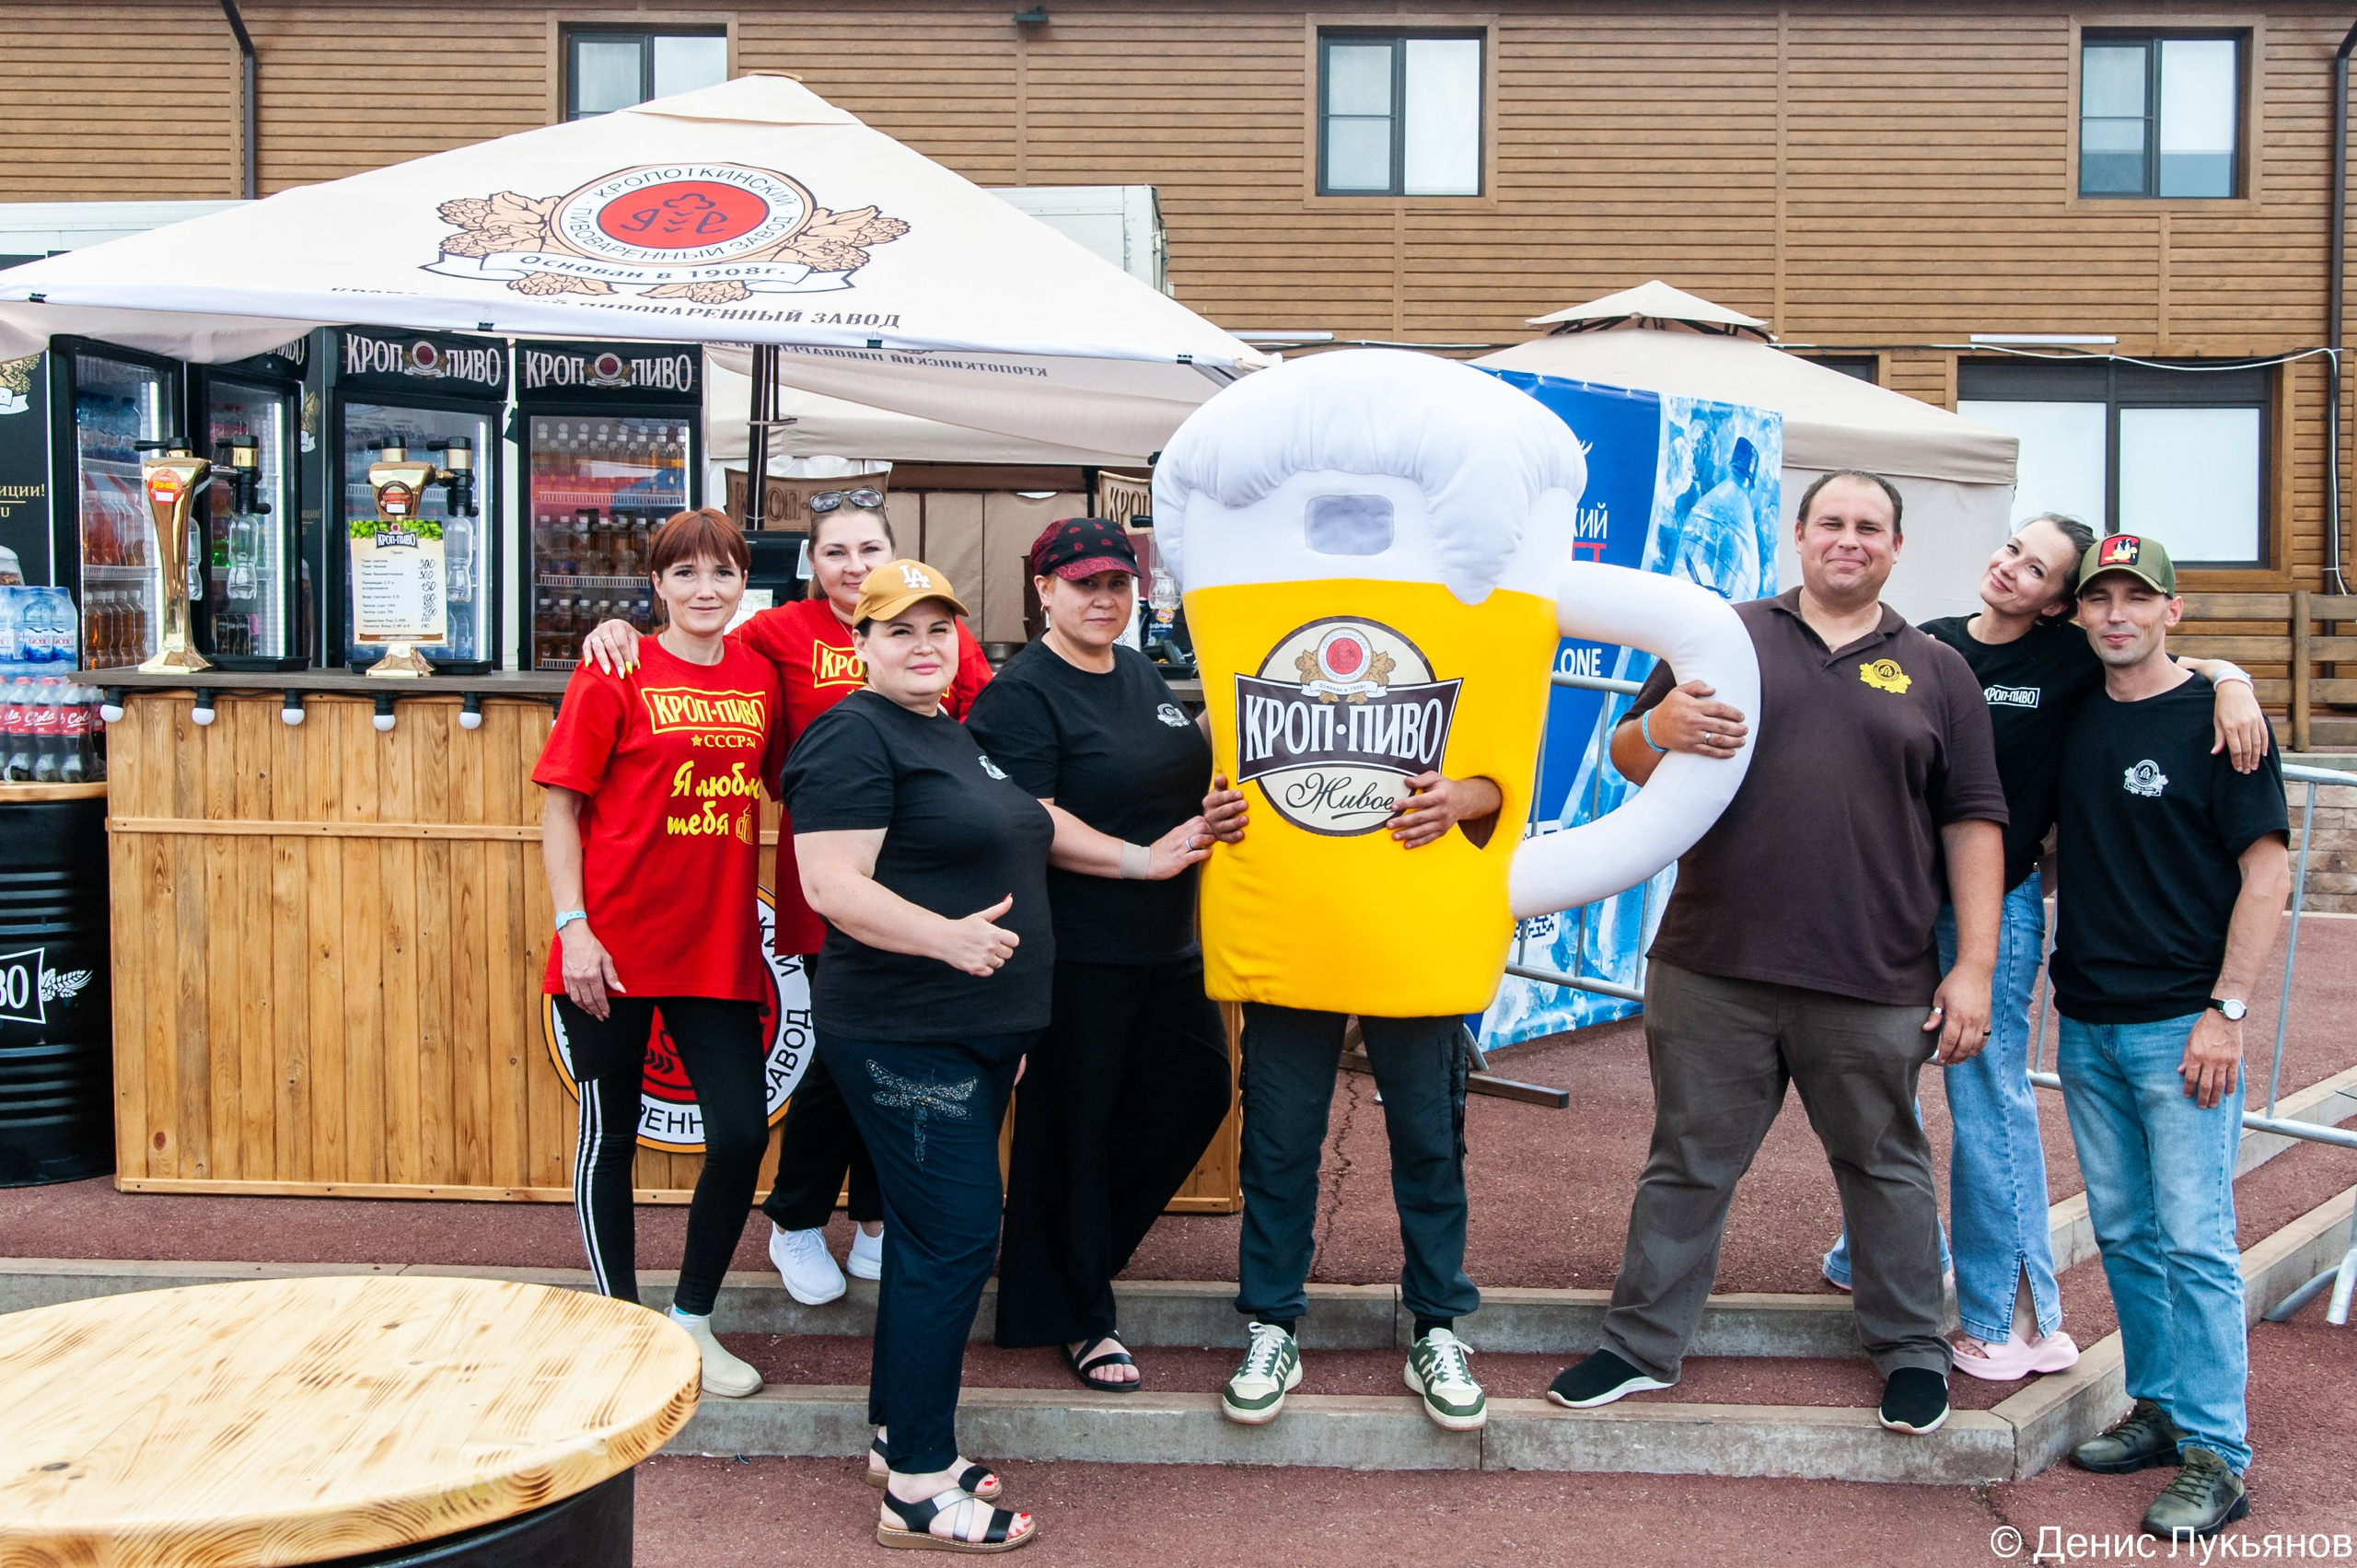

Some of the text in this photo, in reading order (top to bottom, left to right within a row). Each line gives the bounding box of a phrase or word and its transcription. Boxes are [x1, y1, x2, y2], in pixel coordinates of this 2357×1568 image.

[593, 168, 798, 207] КРОПОТКИНСКИЙ
[569, 207, 797, 261] ПИВОВАРЕННЫЙ ЗАВОД
[519, 254, 786, 280] Основан в 1908г.
[810, 311, 901, 330] ЗАВОД
[346, 332, 501, 387] КРОП ПИВО
[526, 350, 692, 392] КРОП ПИВО
[899, 564, 932, 588] LA
[704, 734, 746, 748] СССР
[670, 760, 694, 797] Я
[1285, 772, 1395, 814] Живое
[667, 800, 729, 836] тебя
